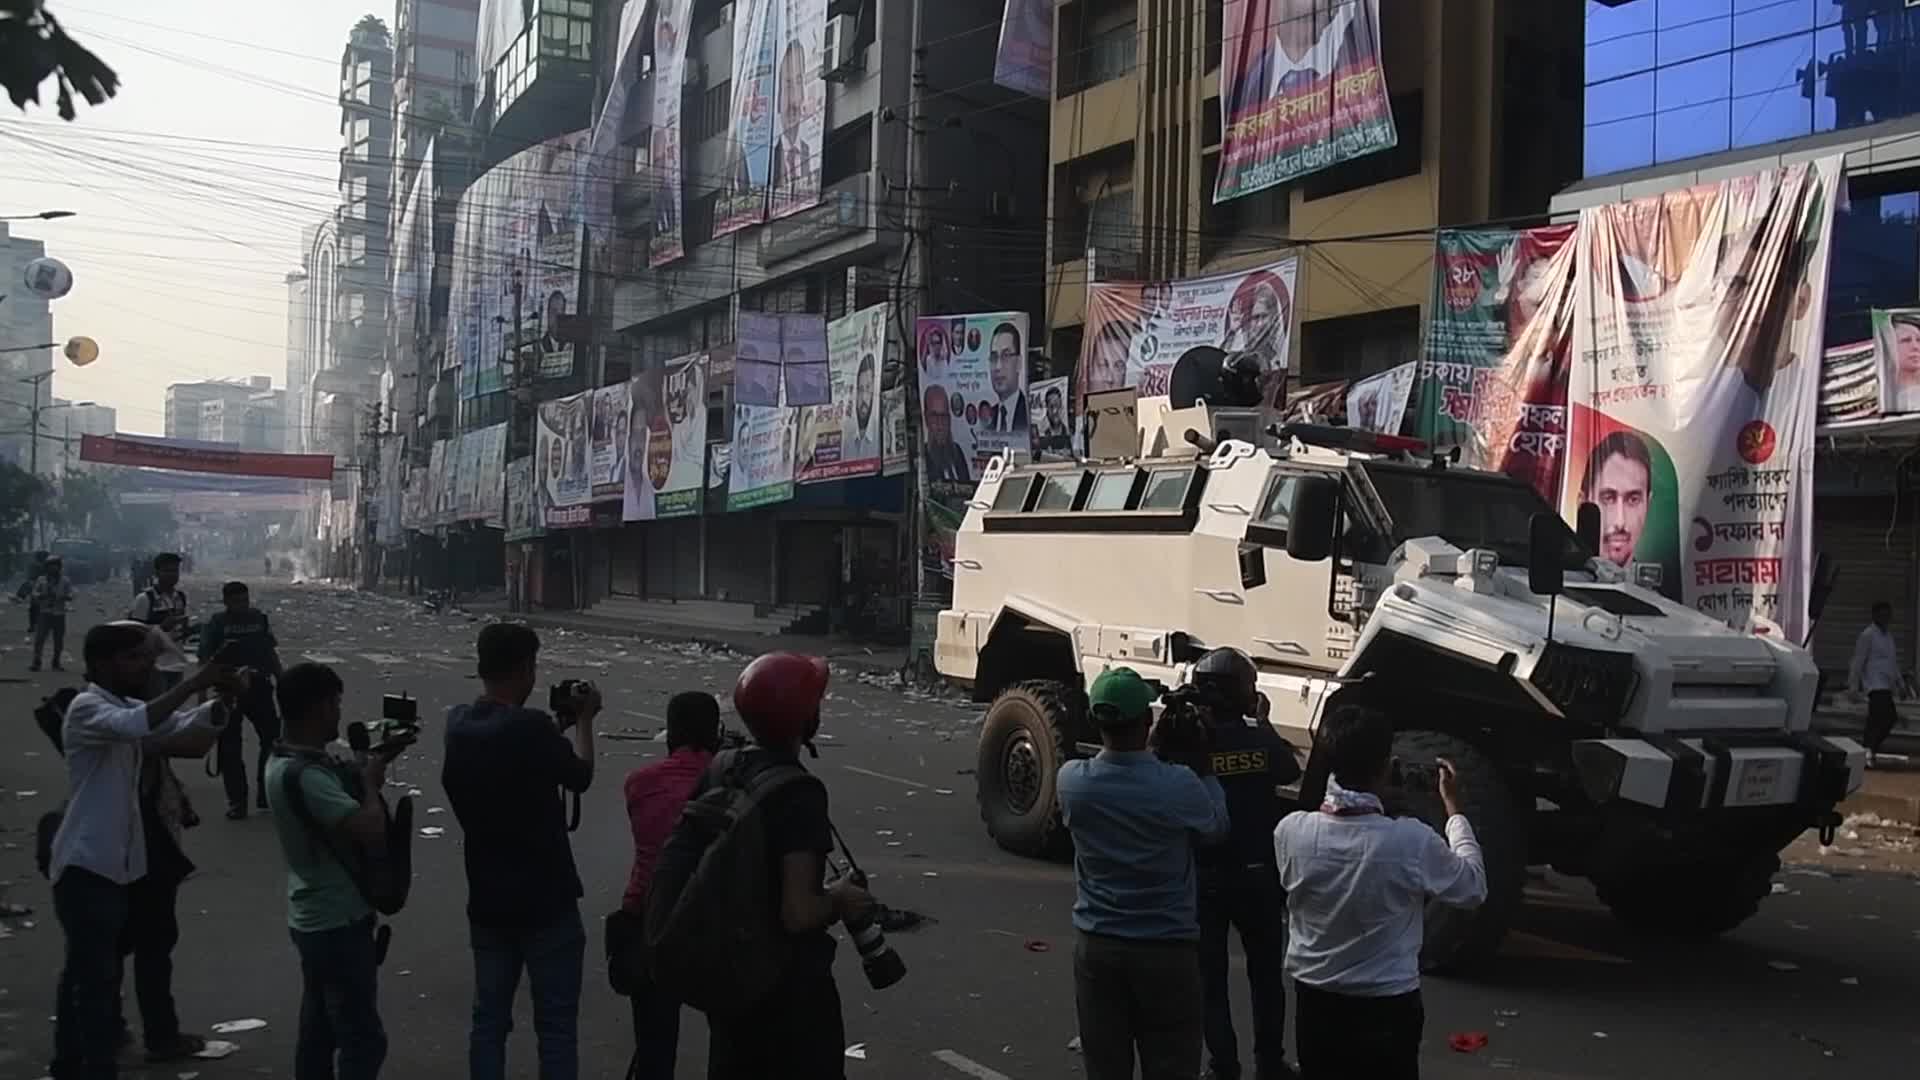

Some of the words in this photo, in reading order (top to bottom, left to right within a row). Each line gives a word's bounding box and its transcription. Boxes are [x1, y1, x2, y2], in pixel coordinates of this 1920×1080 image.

[1452, 265, 1476, 284] ২৮
[1694, 557, 1783, 587] মহাসমা
[1211, 752, 1265, 772] RESS
